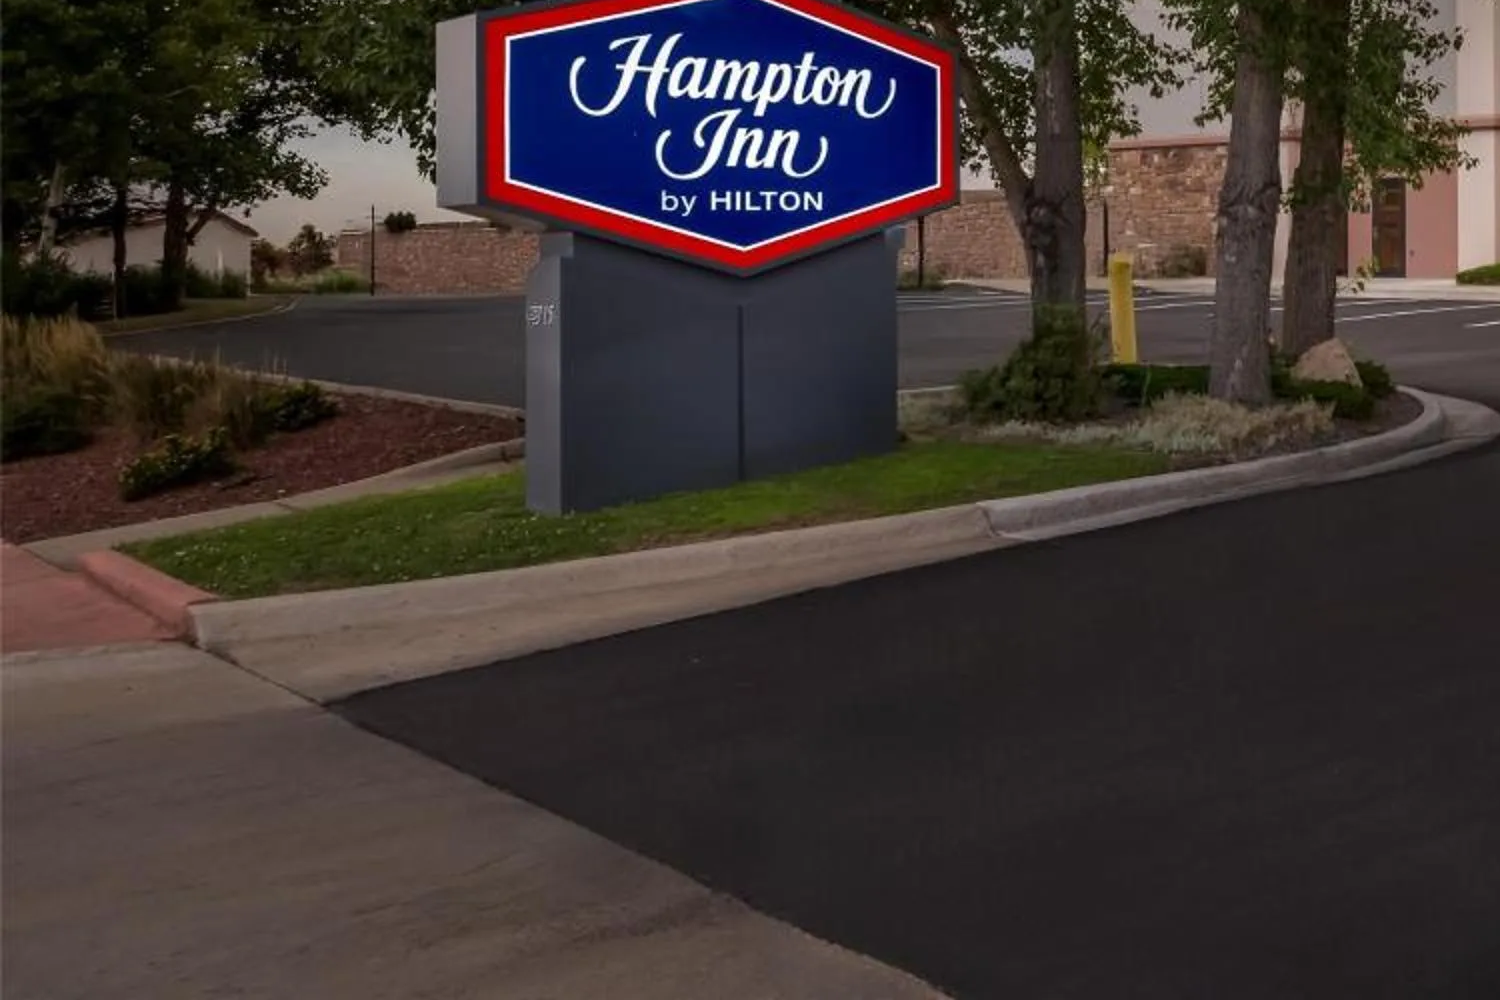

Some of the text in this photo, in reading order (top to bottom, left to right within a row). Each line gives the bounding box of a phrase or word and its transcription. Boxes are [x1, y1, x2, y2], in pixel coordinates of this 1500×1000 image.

[569, 32, 896, 119] Hampton
[655, 107, 829, 180] Inn
[661, 190, 823, 216] by HILTON
